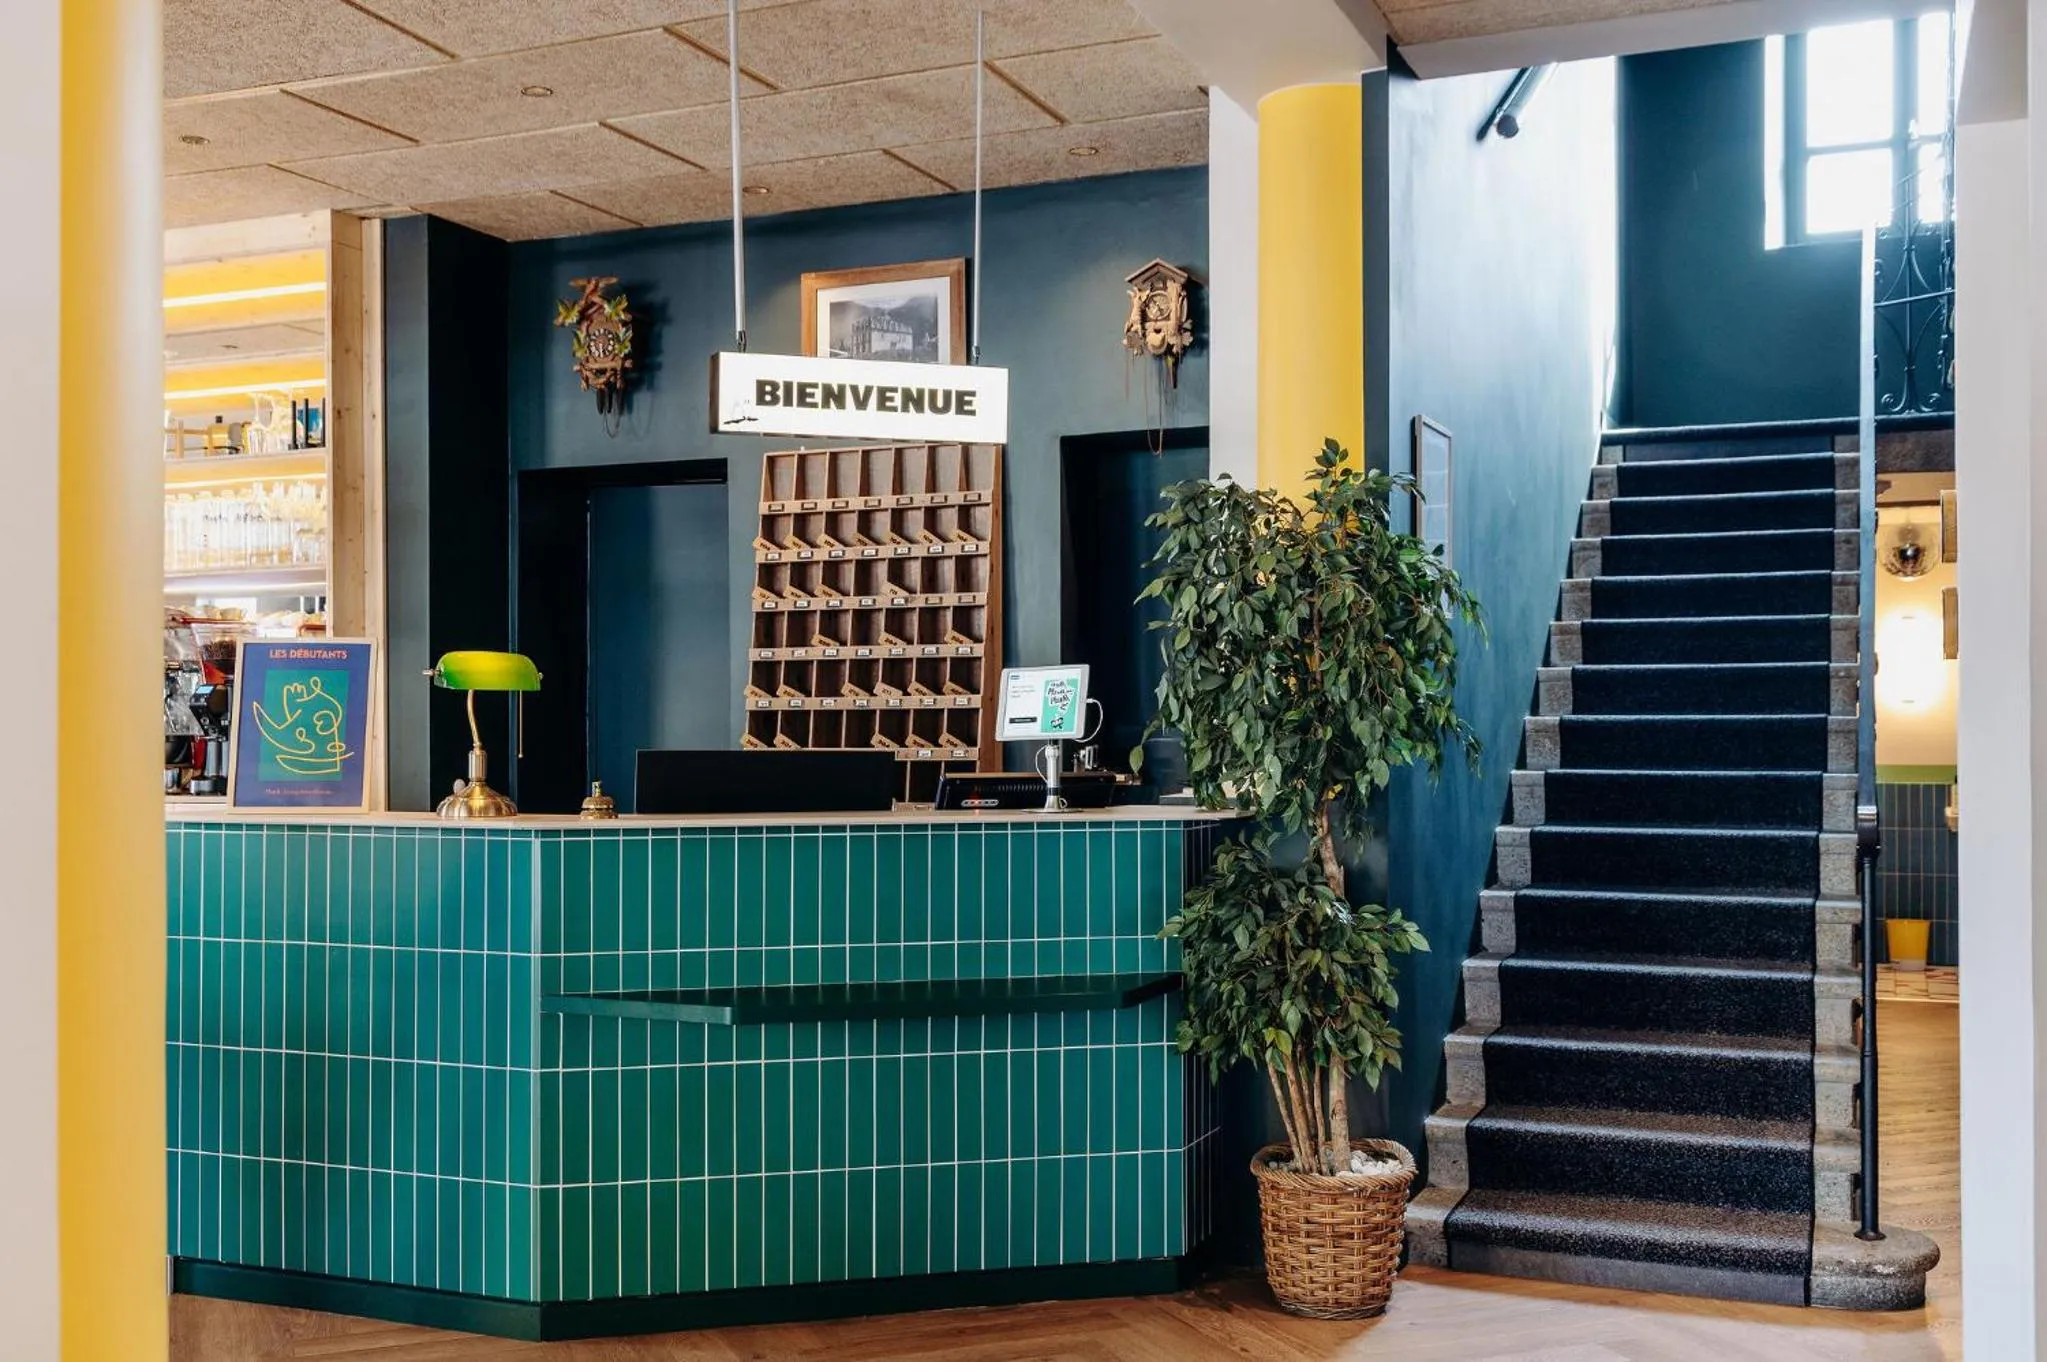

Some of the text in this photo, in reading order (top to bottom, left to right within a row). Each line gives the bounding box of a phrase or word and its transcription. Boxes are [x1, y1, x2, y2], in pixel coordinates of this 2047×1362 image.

[755, 378, 977, 417] BIENVENUE
[269, 647, 348, 659] LES DÉBUTANTS
